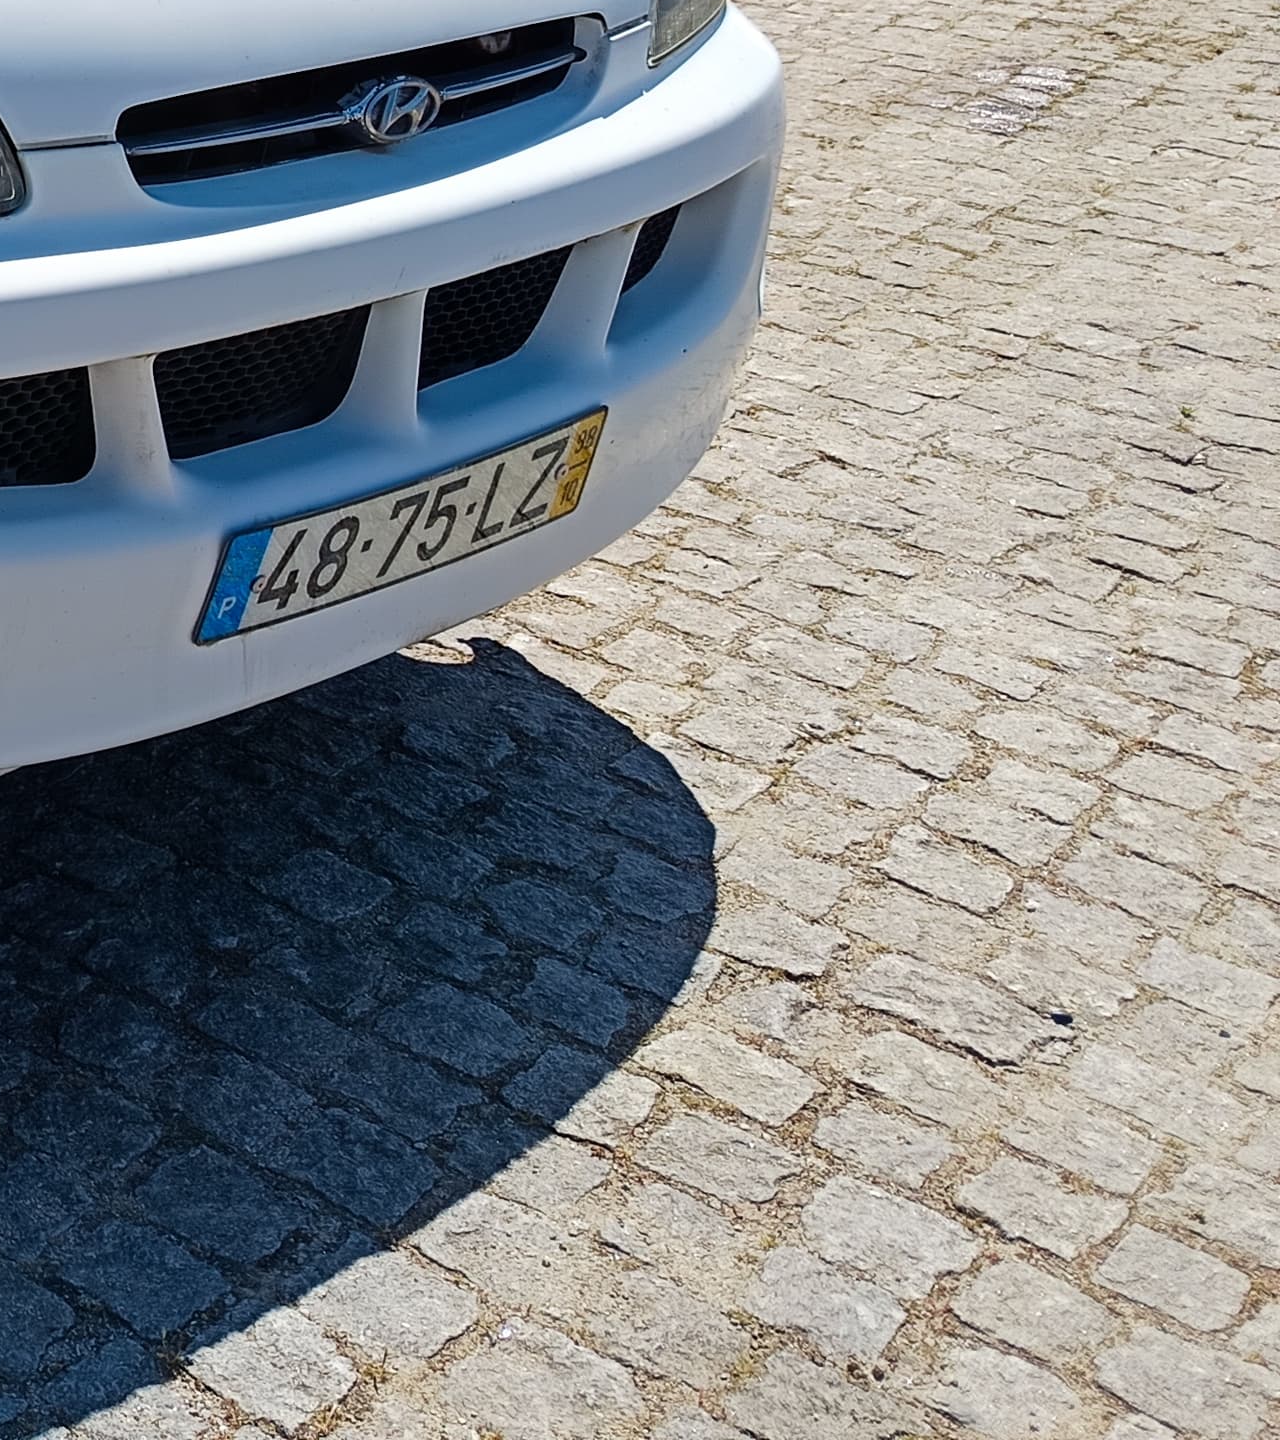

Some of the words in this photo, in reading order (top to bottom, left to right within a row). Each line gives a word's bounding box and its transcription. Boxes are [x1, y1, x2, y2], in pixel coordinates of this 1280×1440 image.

[574, 425, 598, 454] 98
[559, 478, 579, 506] 10
[217, 596, 237, 619] P
